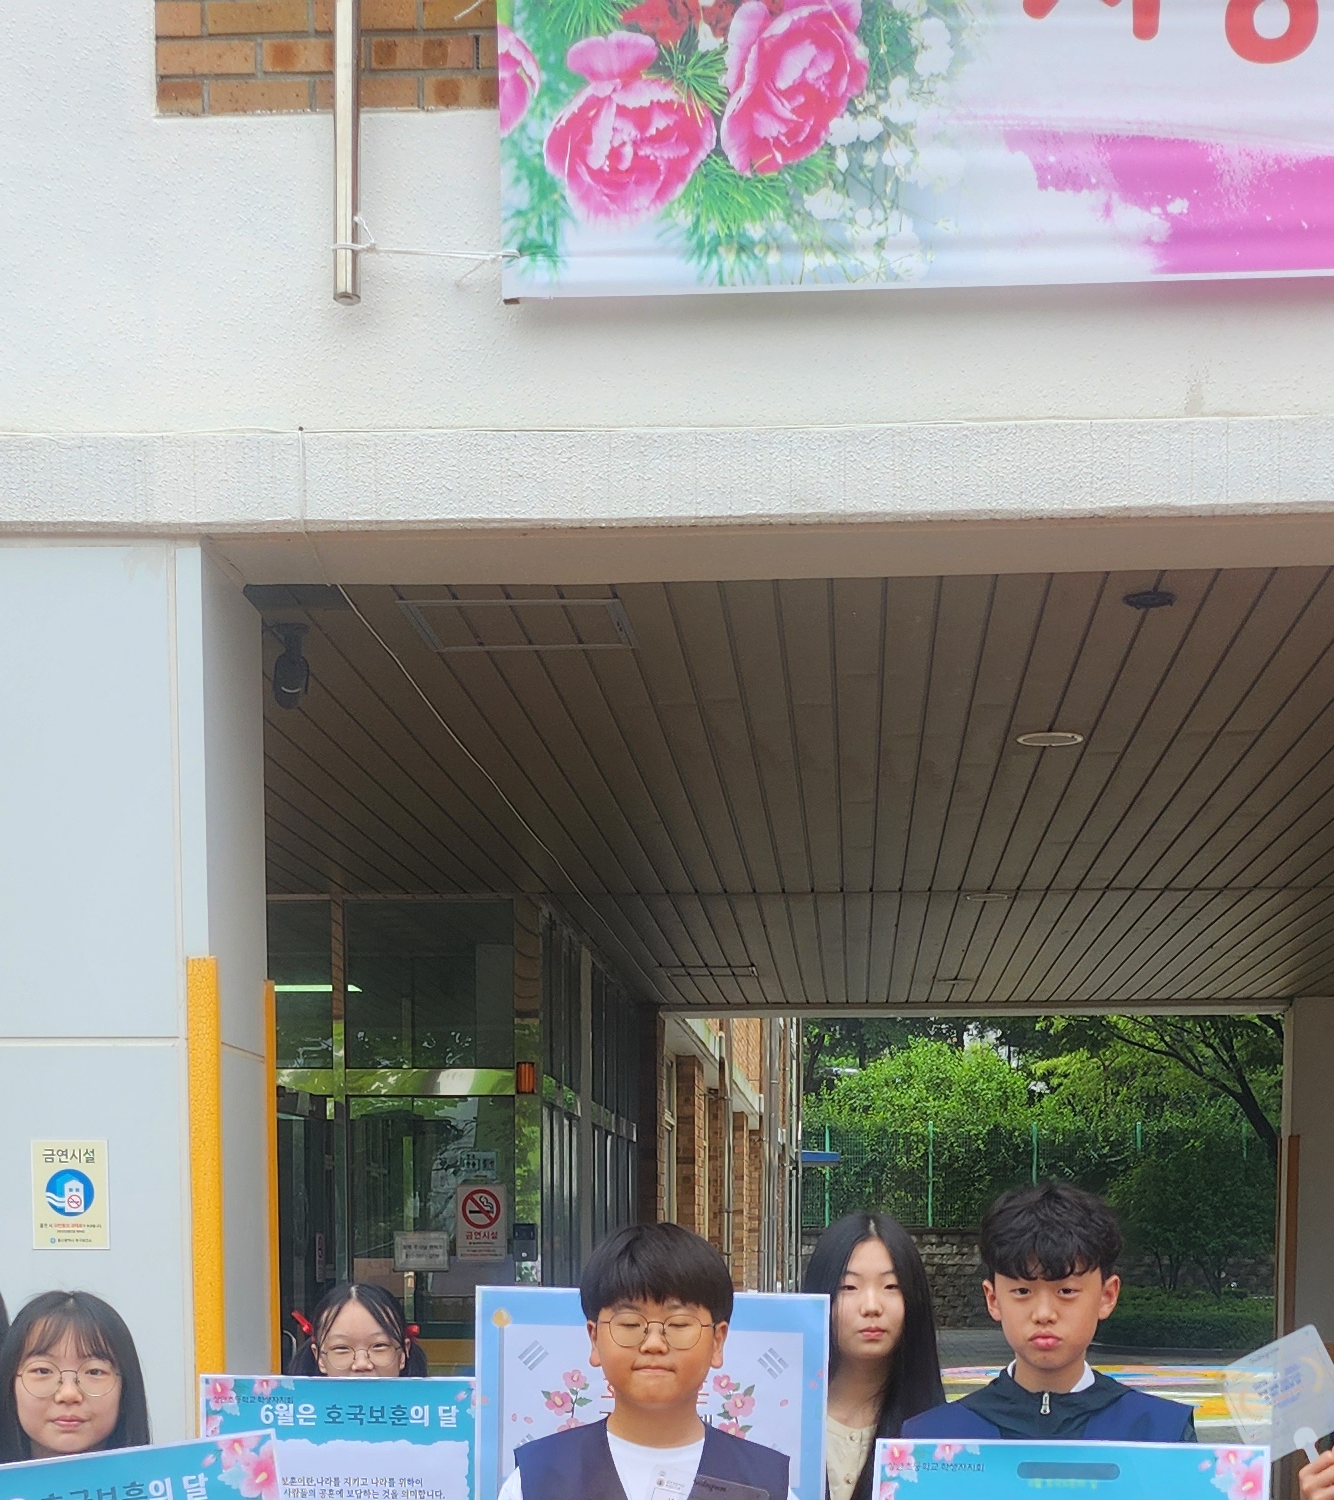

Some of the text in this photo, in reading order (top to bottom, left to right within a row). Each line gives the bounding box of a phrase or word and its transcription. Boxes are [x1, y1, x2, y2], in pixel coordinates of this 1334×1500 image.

[42, 1148, 96, 1164] 금연시설
[465, 1231, 498, 1240] 금연시설
[259, 1403, 460, 1428] 6월은 호국보훈의 달
[343, 1476, 368, 1487] 지키고
[371, 1476, 396, 1487] 나라를
[346, 1488, 380, 1500] 보답하는
[382, 1488, 398, 1500] 것을
[401, 1488, 446, 1500] 의미합니다.
